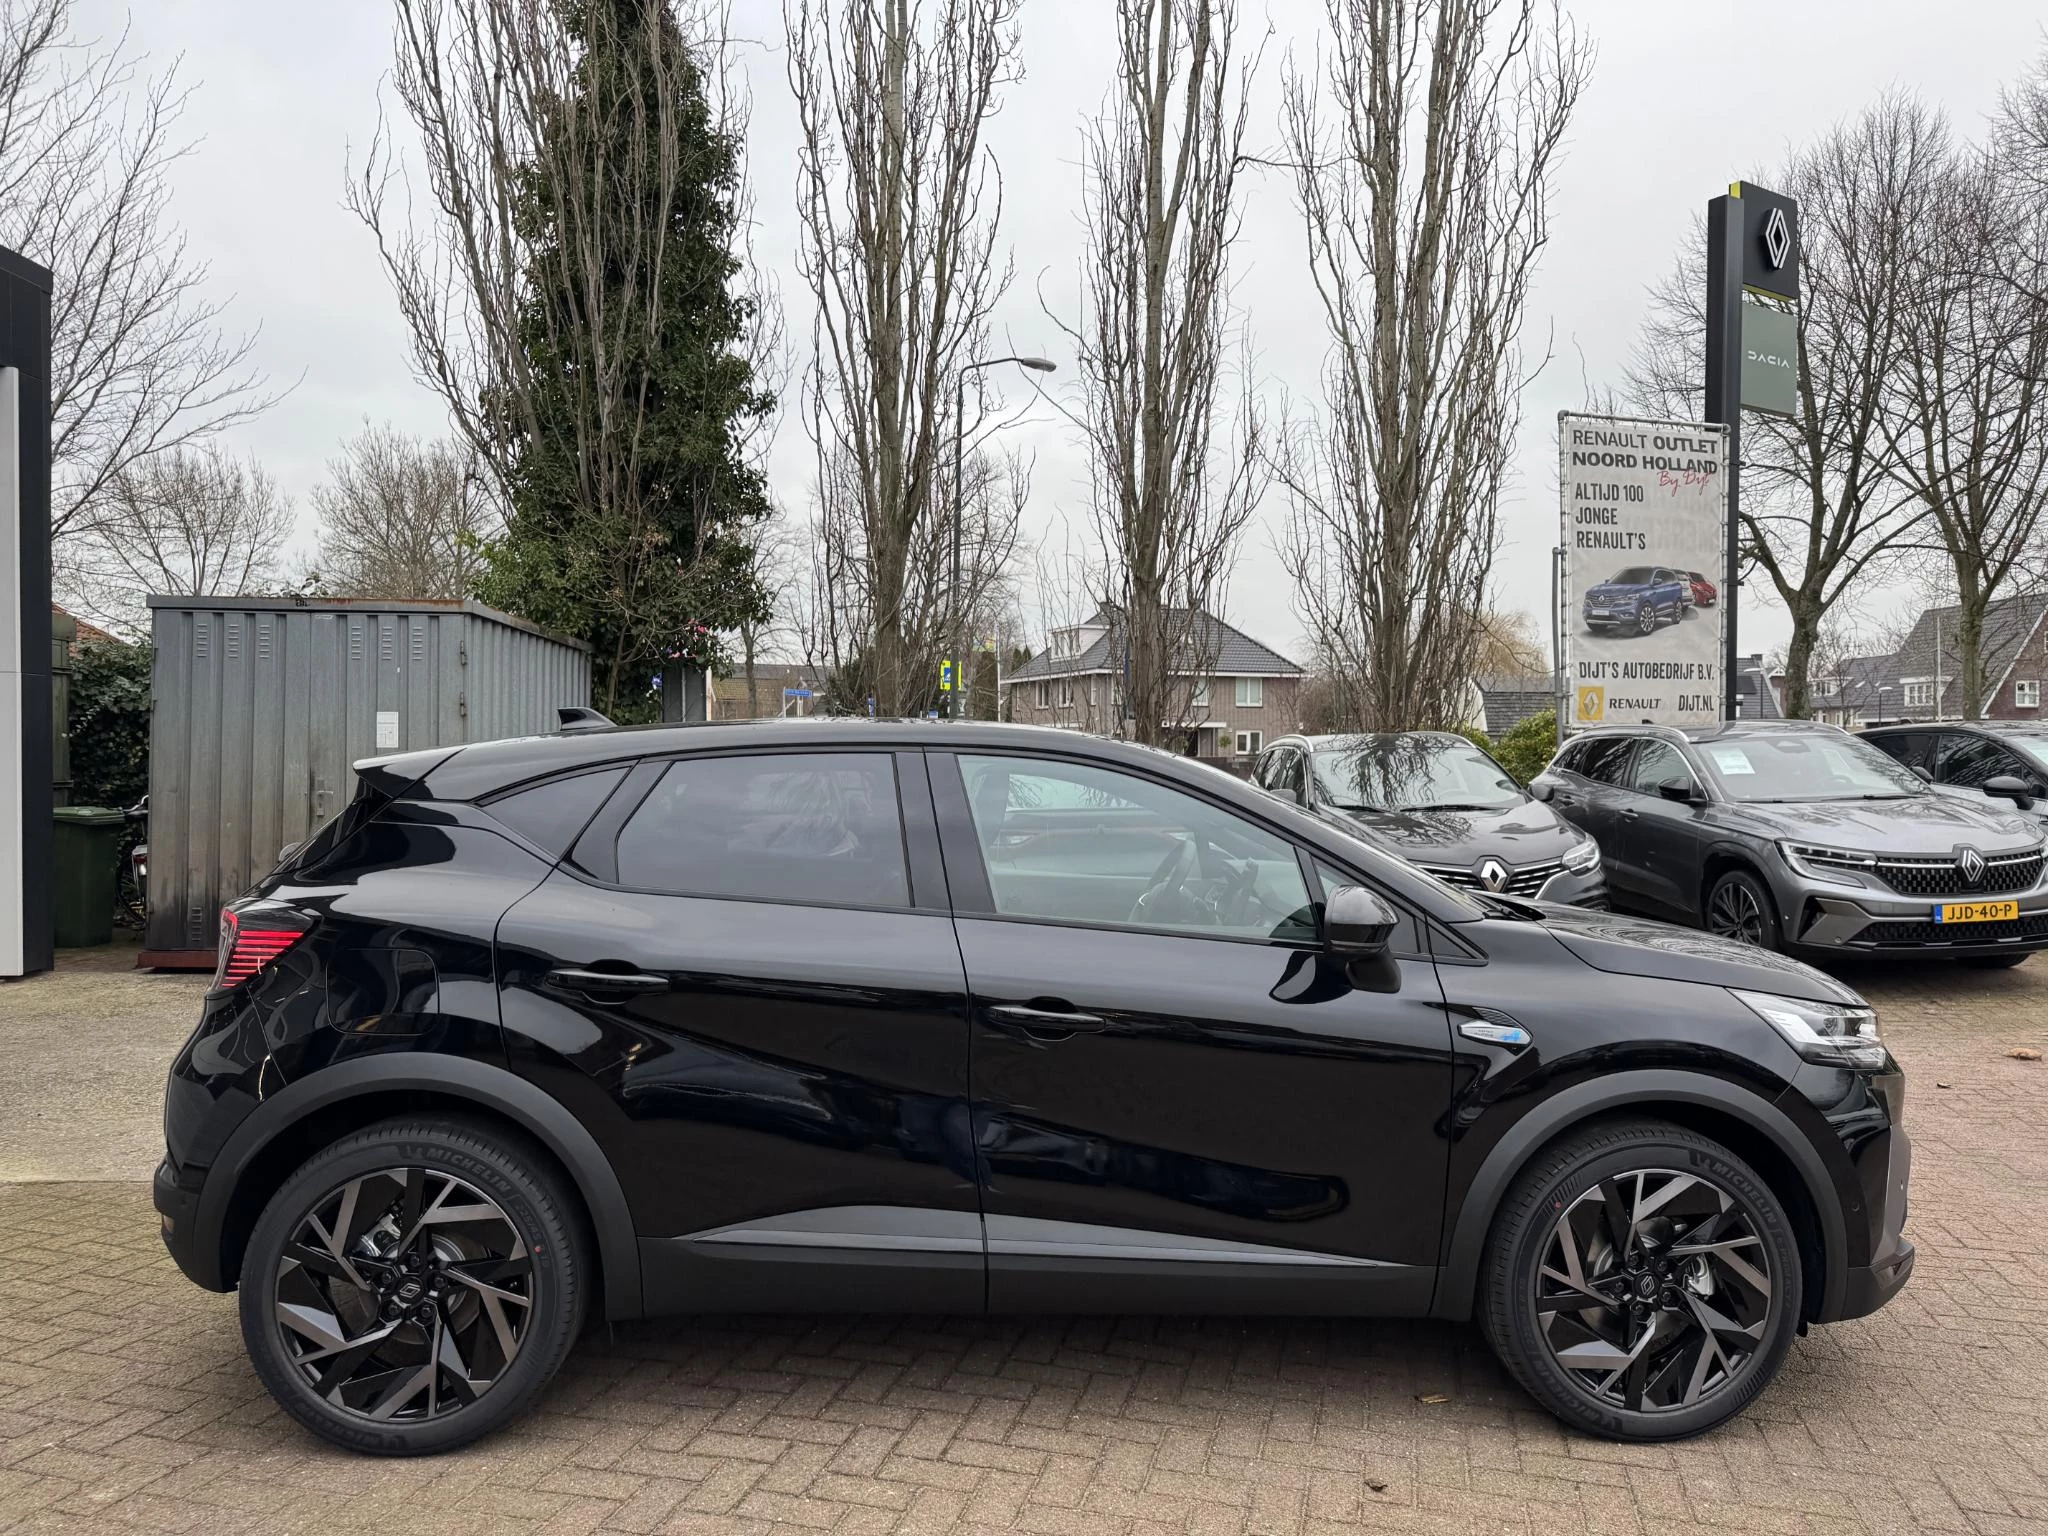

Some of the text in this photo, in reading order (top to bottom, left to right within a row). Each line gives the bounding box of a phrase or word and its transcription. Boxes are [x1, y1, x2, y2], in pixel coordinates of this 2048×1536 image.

[1747, 350, 1790, 369] DACIA
[1573, 429, 1717, 454] RENAULT OUTLET
[1572, 451, 1718, 474] NOORD HOLLAND
[1575, 482, 1644, 502] ALTIJD 100
[1657, 470, 1679, 497] By
[1575, 506, 1618, 525] JONGE
[1576, 530, 1646, 550] RENAULT'S
[1579, 661, 1715, 680] DIJT'S AUTOBEDRIJF B.V.
[1609, 694, 1714, 712] RENAULT DIJT.NL
[1947, 903, 2012, 920] JJD-40-P
[427, 1148, 512, 1195] MICHELIN
[1714, 1162, 1777, 1224] MICHELIN
